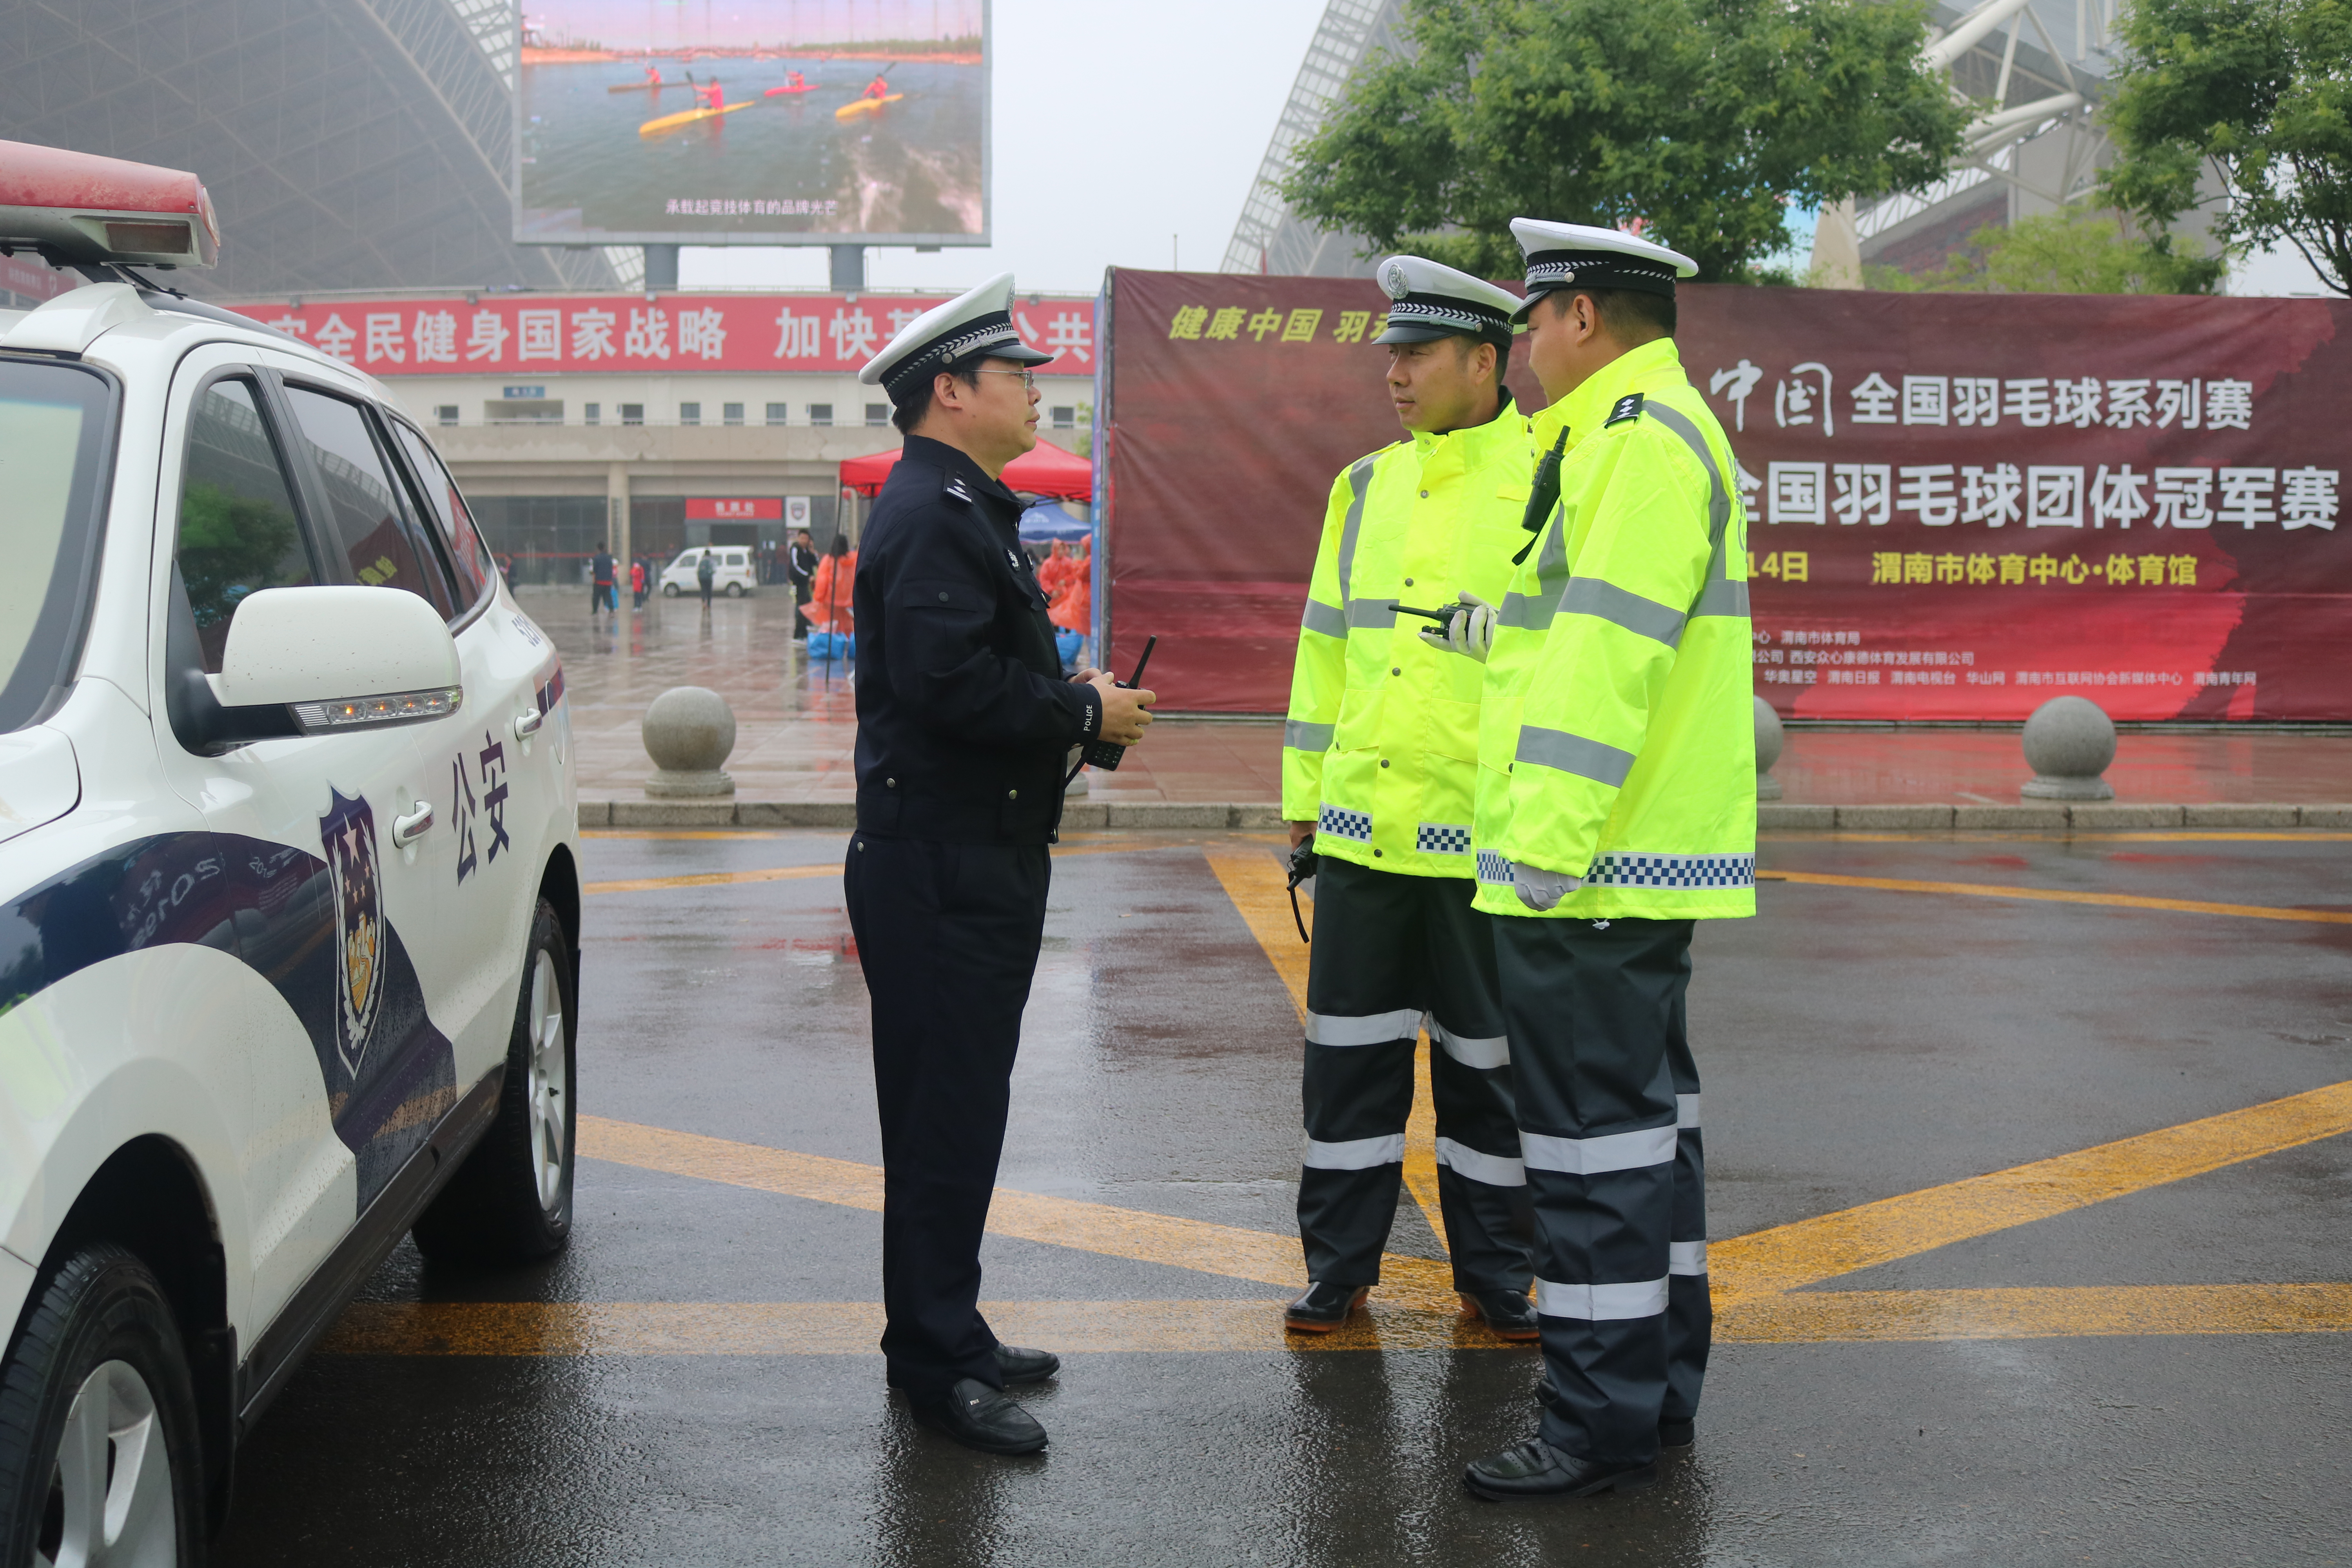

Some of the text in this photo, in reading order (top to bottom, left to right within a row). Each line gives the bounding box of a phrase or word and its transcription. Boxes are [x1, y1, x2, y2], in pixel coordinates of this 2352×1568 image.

[1169, 305, 1323, 343] 健康中国
[1709, 358, 2252, 437] 中国 全国羽毛球系列赛
[1781, 630, 1861, 646] 渭南市体育局
[1827, 670, 1880, 685] 渭南日报
[1891, 670, 1956, 686] 渭南电视台
[1966, 671, 2005, 686] 华山网
[2193, 671, 2256, 686] 渭南青年网
[1083, 704, 1093, 731] POLICE
[452, 729, 509, 887] 公安
